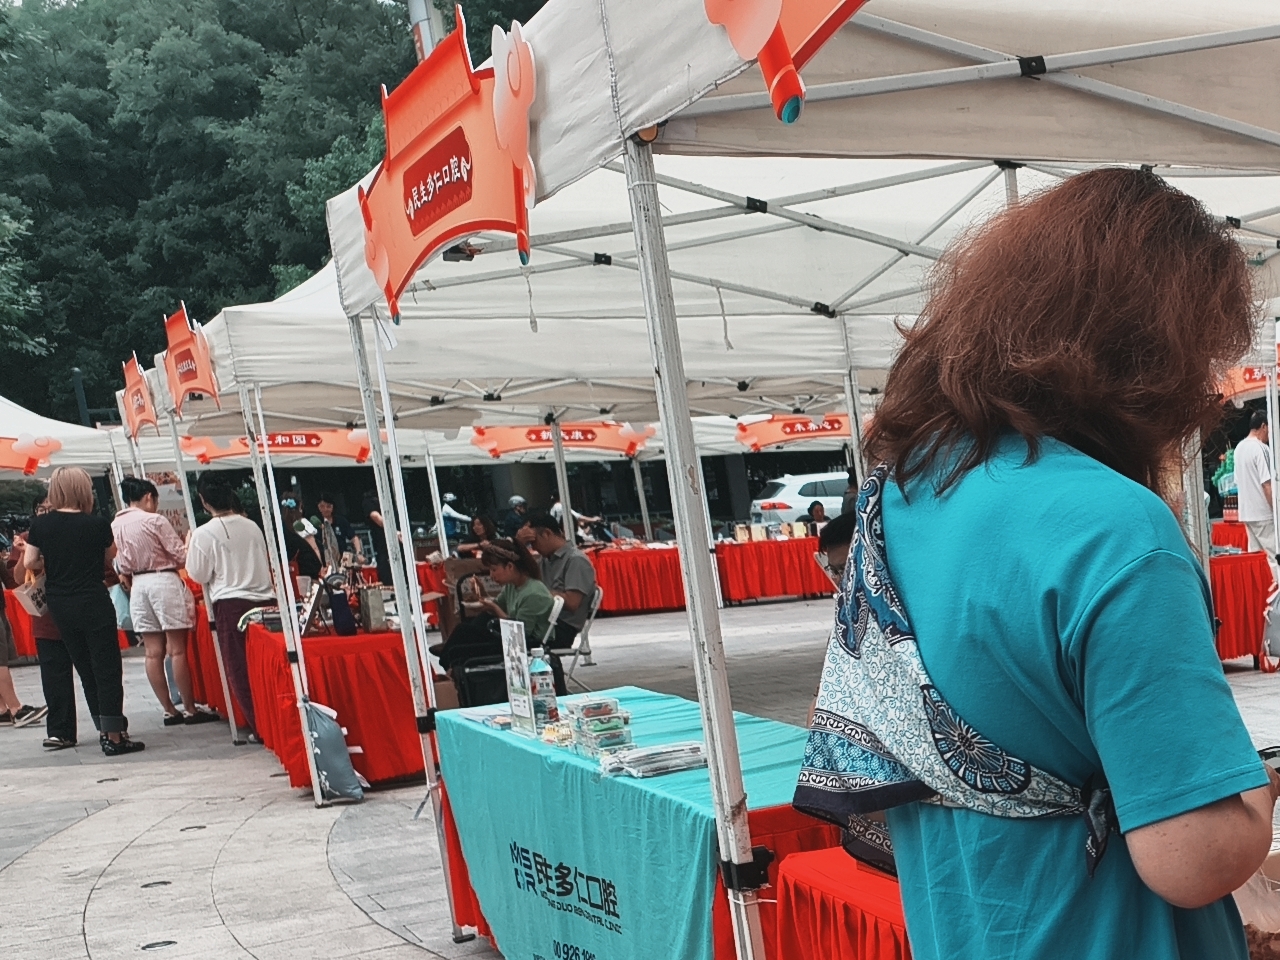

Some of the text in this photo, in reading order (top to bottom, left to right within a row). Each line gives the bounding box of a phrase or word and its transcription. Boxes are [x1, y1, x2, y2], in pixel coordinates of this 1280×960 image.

[411, 155, 461, 210] 民生多仁口腔
